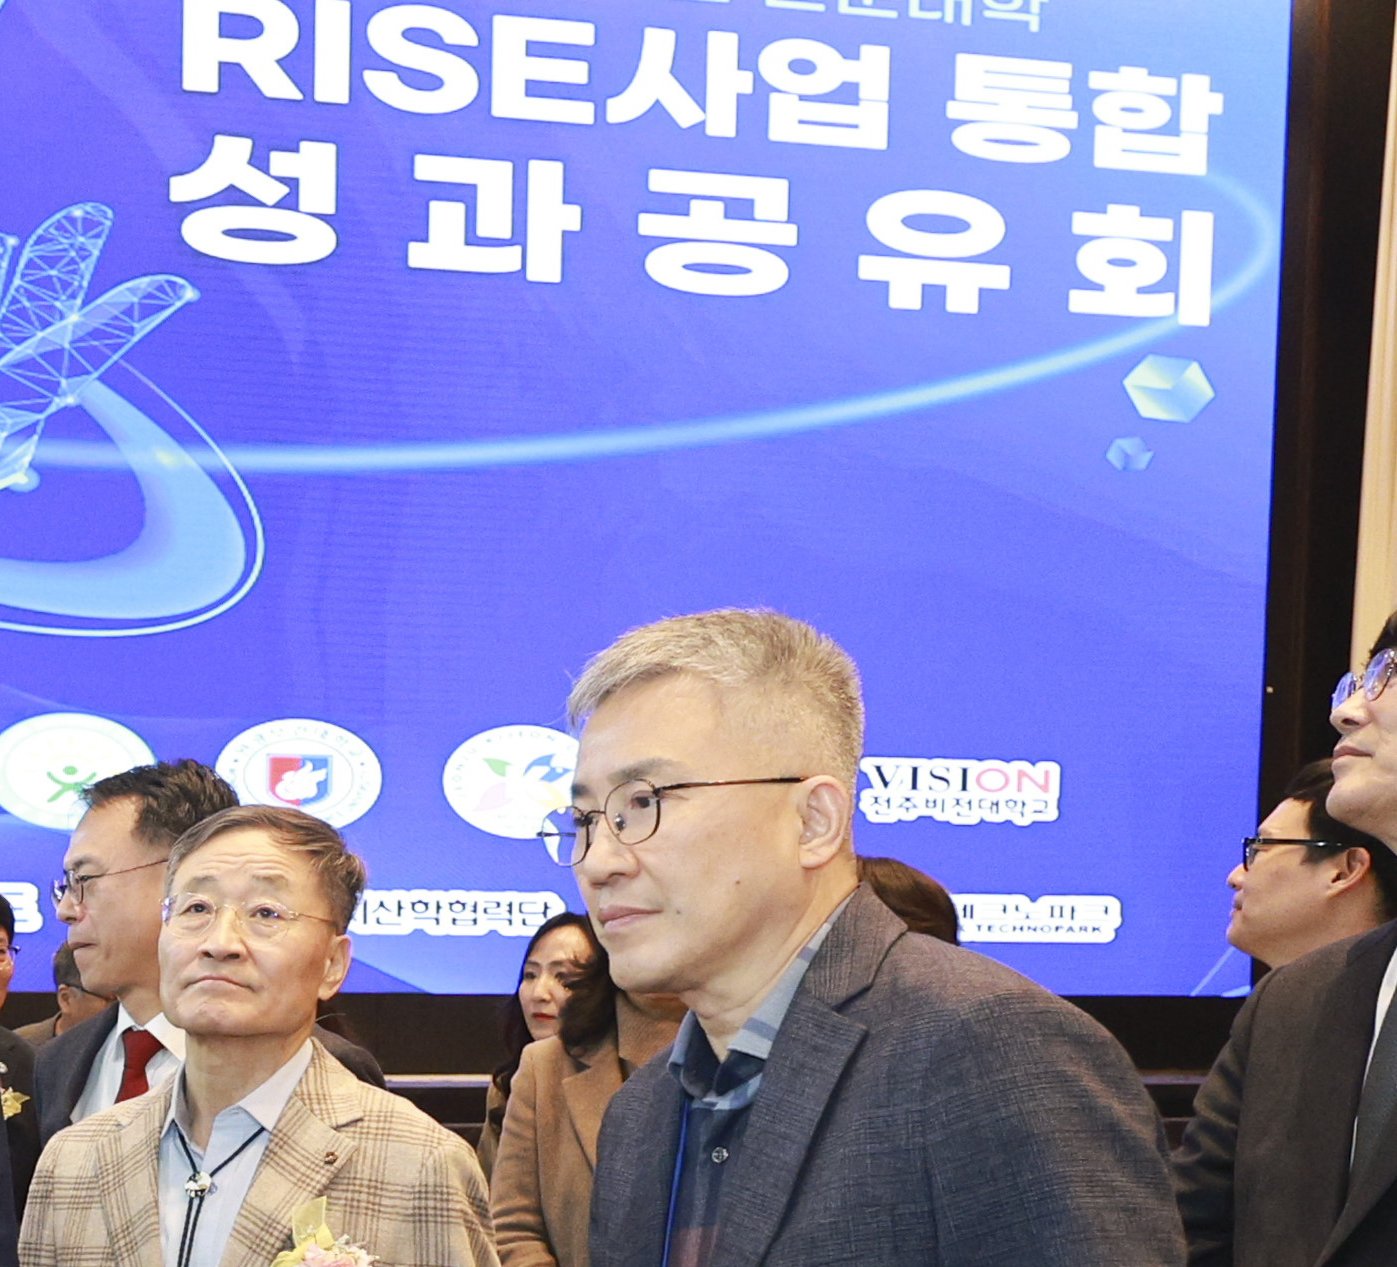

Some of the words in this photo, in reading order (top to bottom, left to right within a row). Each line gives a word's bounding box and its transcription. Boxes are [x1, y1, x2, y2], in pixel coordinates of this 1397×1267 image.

[181, 0, 890, 150] RISE사업
[946, 53, 1224, 176] 통합
[872, 765, 1050, 794] VISION
[976, 924, 1102, 933] TECHNOPARK
